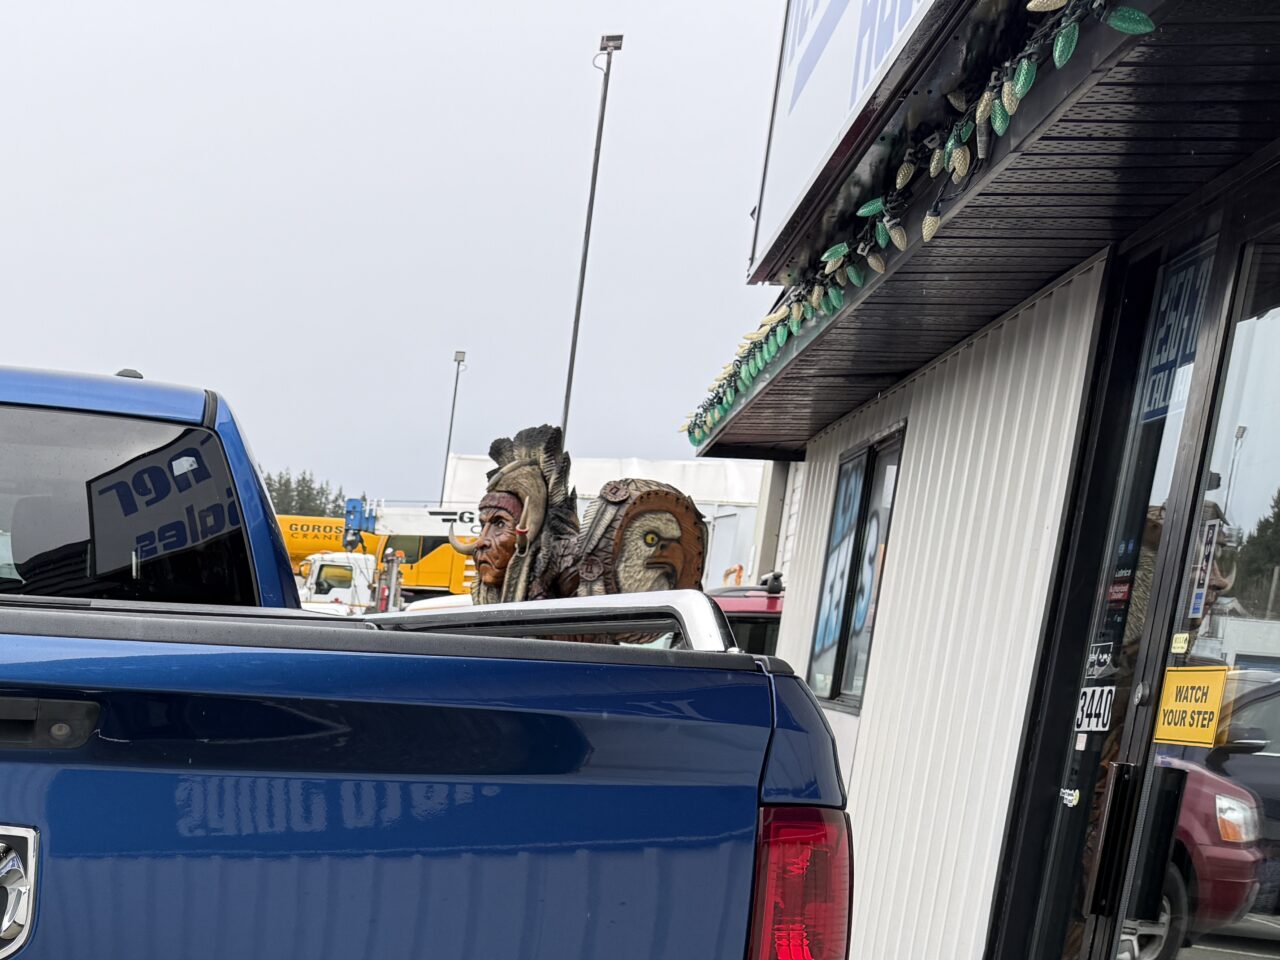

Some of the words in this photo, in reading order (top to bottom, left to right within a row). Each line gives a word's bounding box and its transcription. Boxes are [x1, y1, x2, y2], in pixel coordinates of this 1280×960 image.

[1174, 685, 1210, 704] WATCH
[1076, 689, 1114, 729] 3440
[1161, 708, 1186, 727] YOUR
[1188, 710, 1215, 729] STEP
